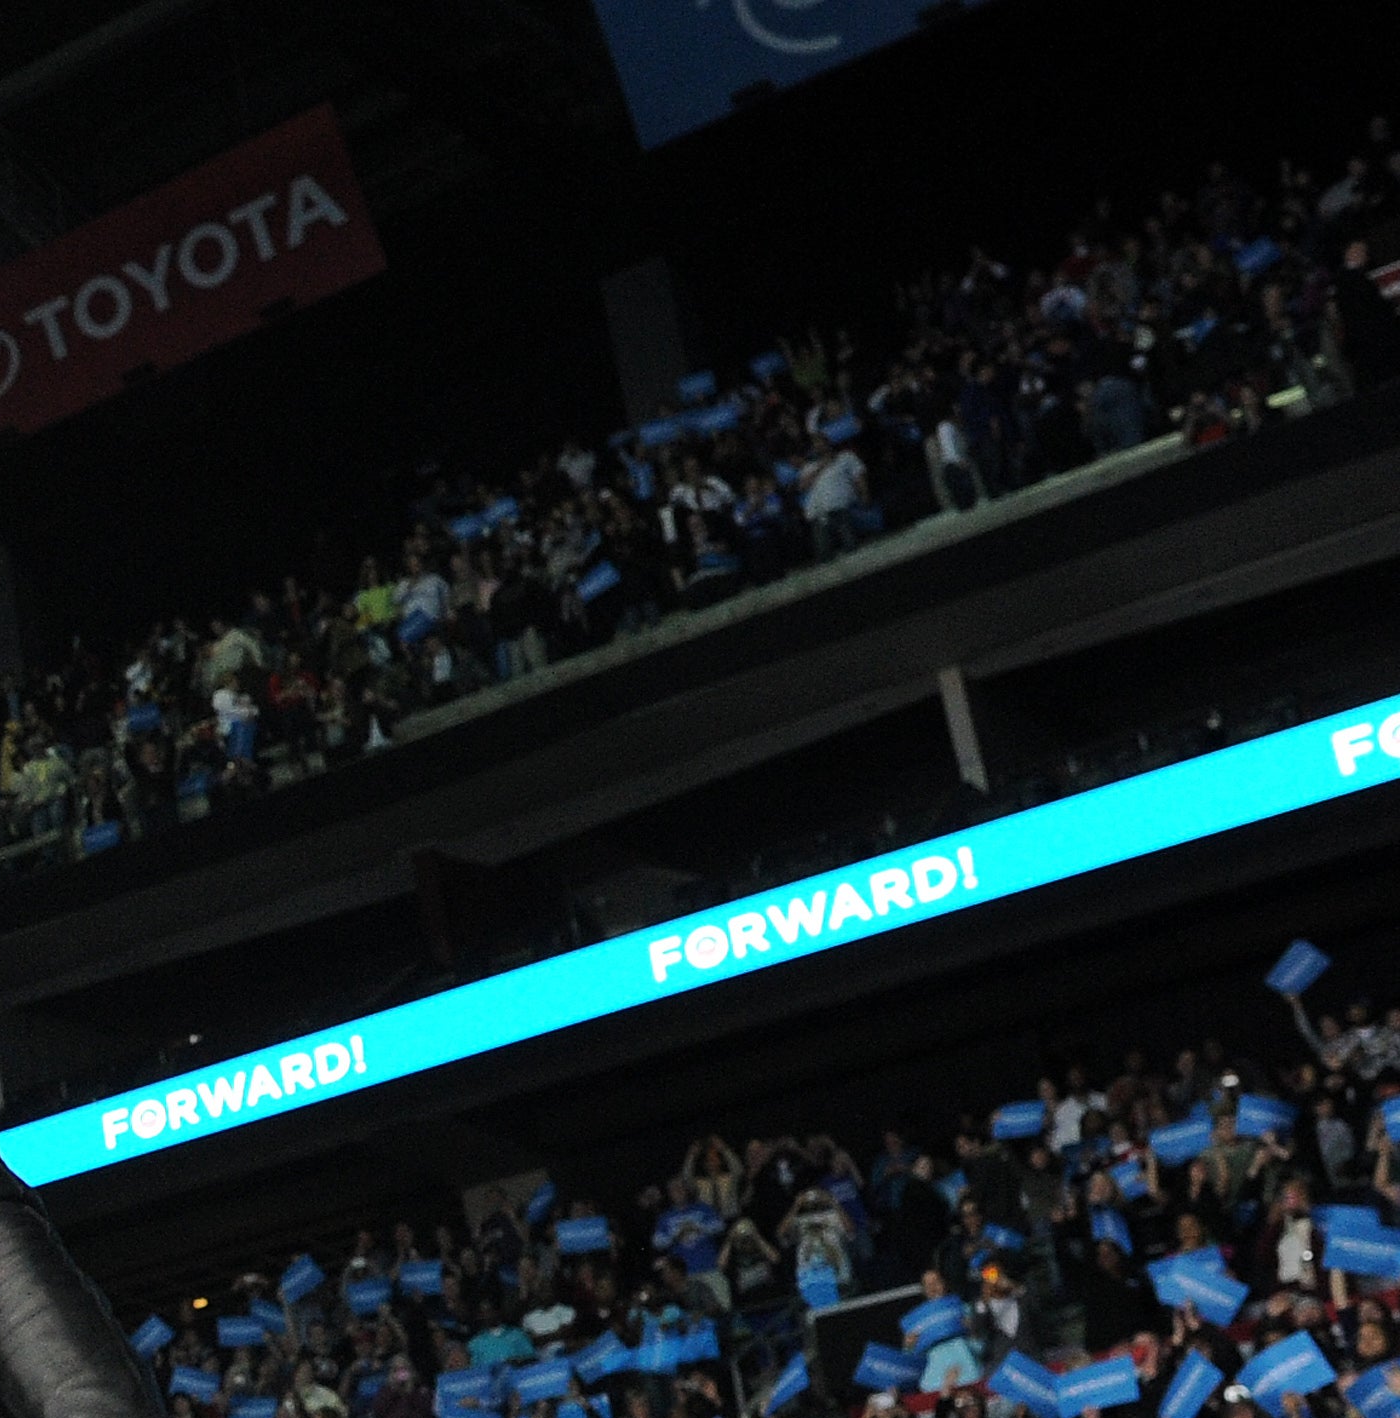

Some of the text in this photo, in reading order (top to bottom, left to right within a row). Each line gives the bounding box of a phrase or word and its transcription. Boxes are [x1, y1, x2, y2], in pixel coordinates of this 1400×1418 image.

[24, 174, 349, 361] TOYOTA
[649, 847, 979, 983] FORWARD!
[102, 1035, 367, 1150] FORWARD!
